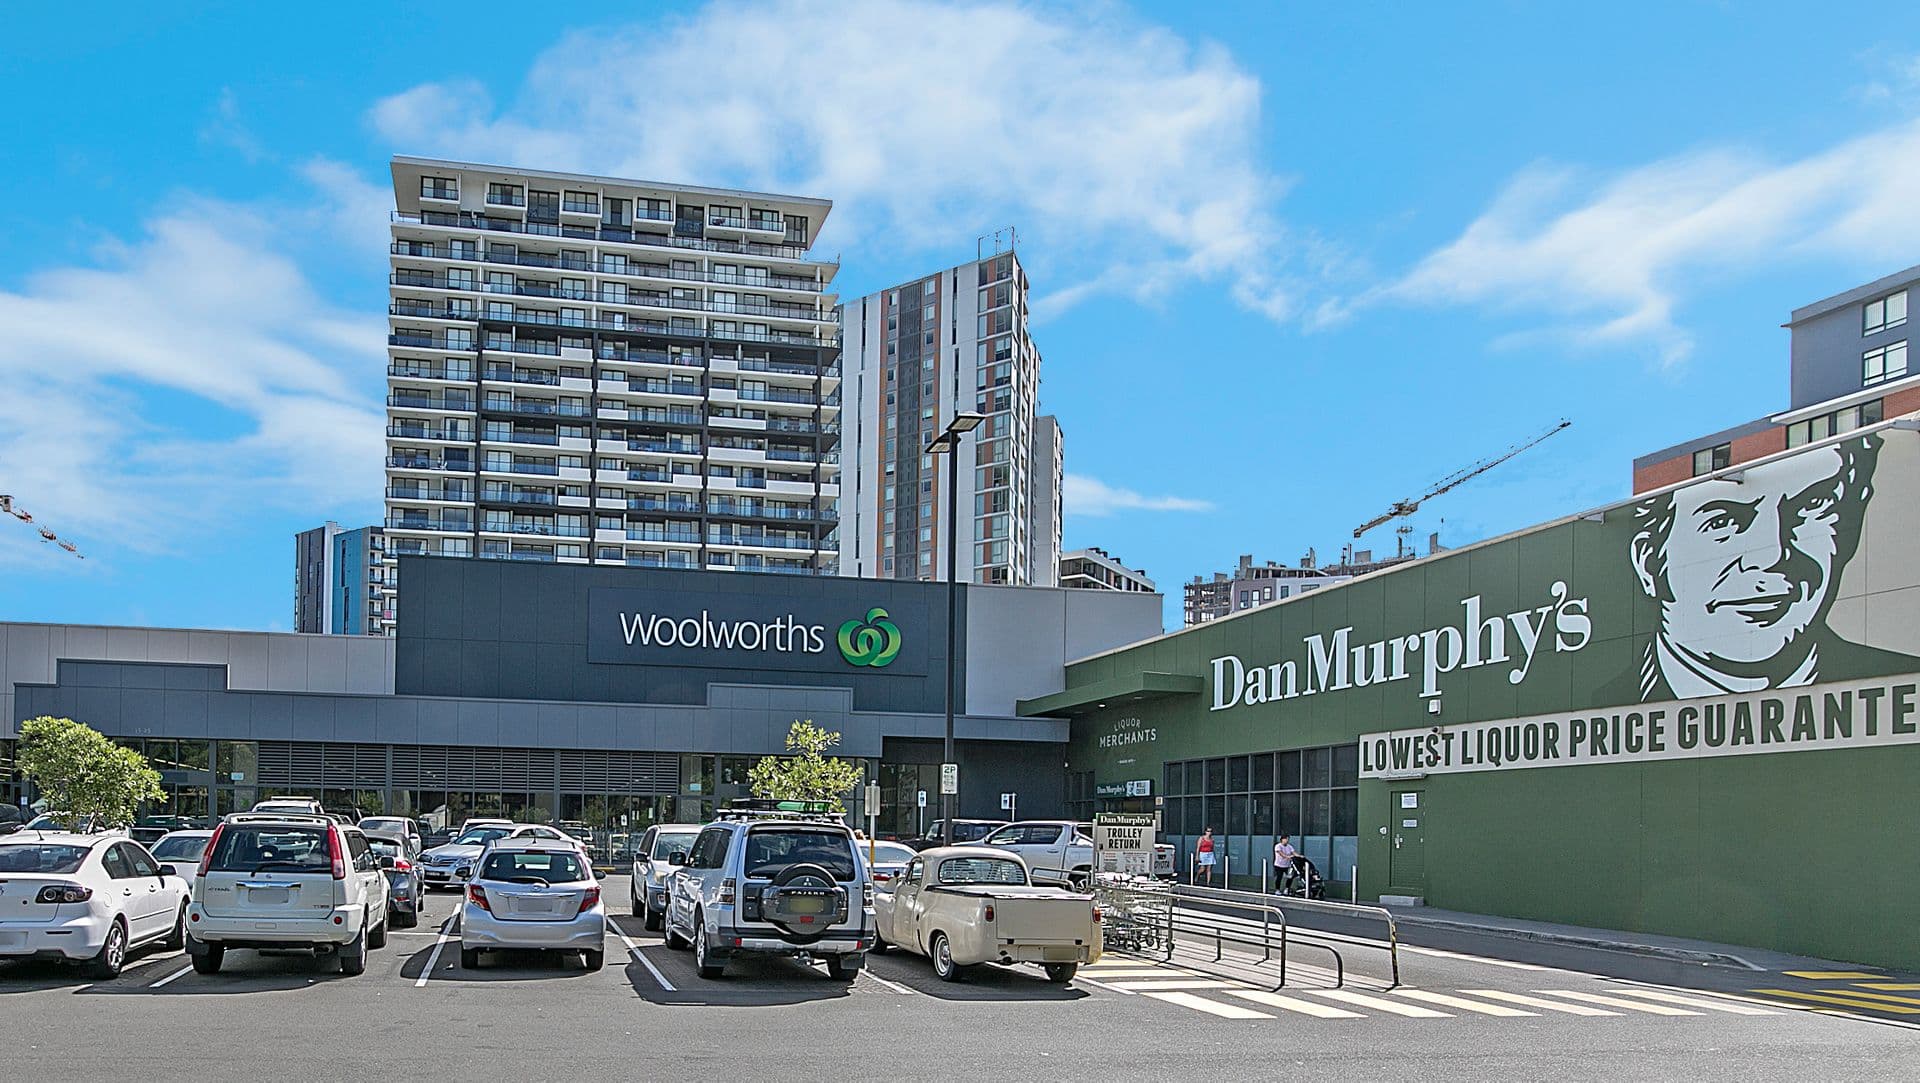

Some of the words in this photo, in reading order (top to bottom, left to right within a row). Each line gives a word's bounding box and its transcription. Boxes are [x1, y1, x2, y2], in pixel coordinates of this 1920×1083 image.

[619, 610, 825, 653] Woolworths
[1210, 655, 1299, 711] Dan
[1303, 581, 1592, 698] Murphy's
[1113, 717, 1141, 732] LIQUOR
[1099, 727, 1157, 748] MERCHANTS
[1363, 732, 1454, 772] LOWEST
[1461, 721, 1560, 767] LIQUOR
[1569, 710, 1666, 758] PRICE
[1100, 815, 1116, 824] Dan
[1116, 815, 1151, 826] Murphy's
[1107, 827, 1143, 838] TROLLEY
[1108, 838, 1141, 849] RETURN
[1153, 860, 1170, 870] OYOTA
